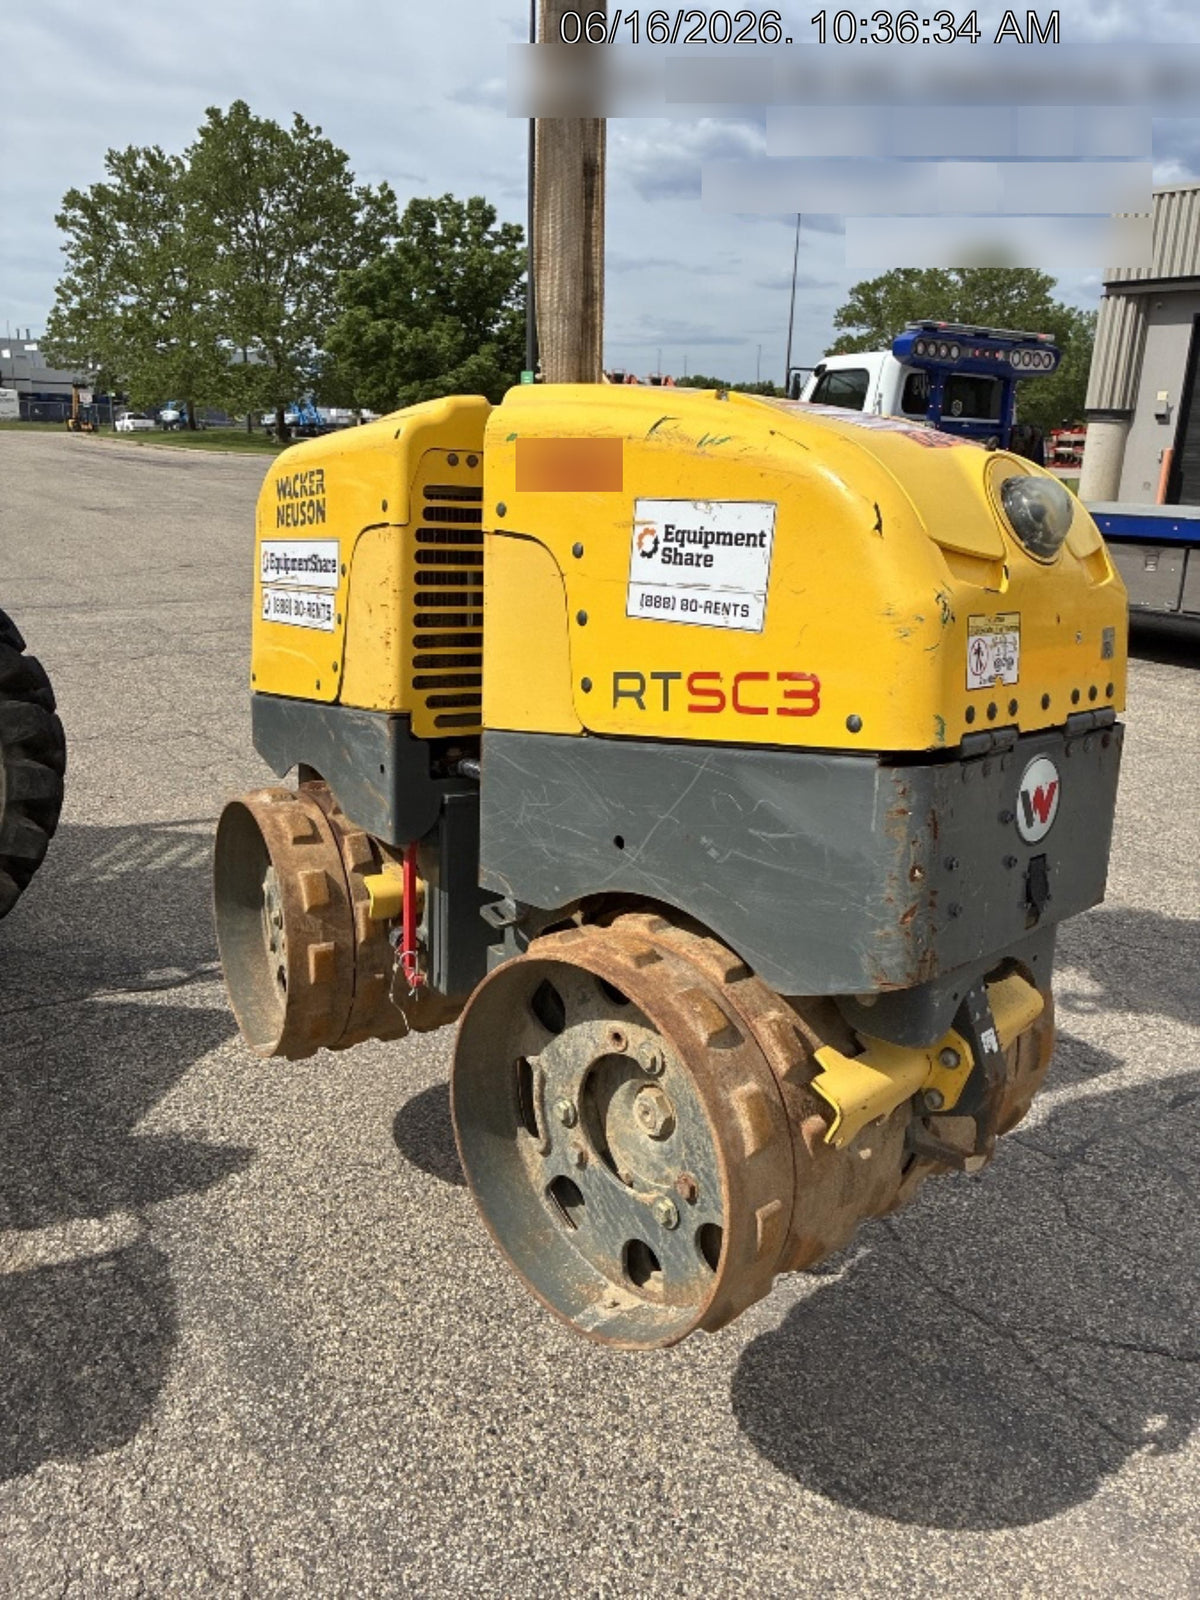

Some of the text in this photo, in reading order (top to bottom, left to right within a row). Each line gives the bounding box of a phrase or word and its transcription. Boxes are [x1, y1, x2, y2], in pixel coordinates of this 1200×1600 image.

[276, 469, 325, 501] WACKER
[277, 498, 326, 528] NEUSON
[663, 524, 767, 548] Equipment
[270, 553, 337, 575] EquipmentShare
[661, 547, 714, 568] Share
[680, 598, 750, 618] 80-RENTS
[1021, 780, 1059, 829] W
